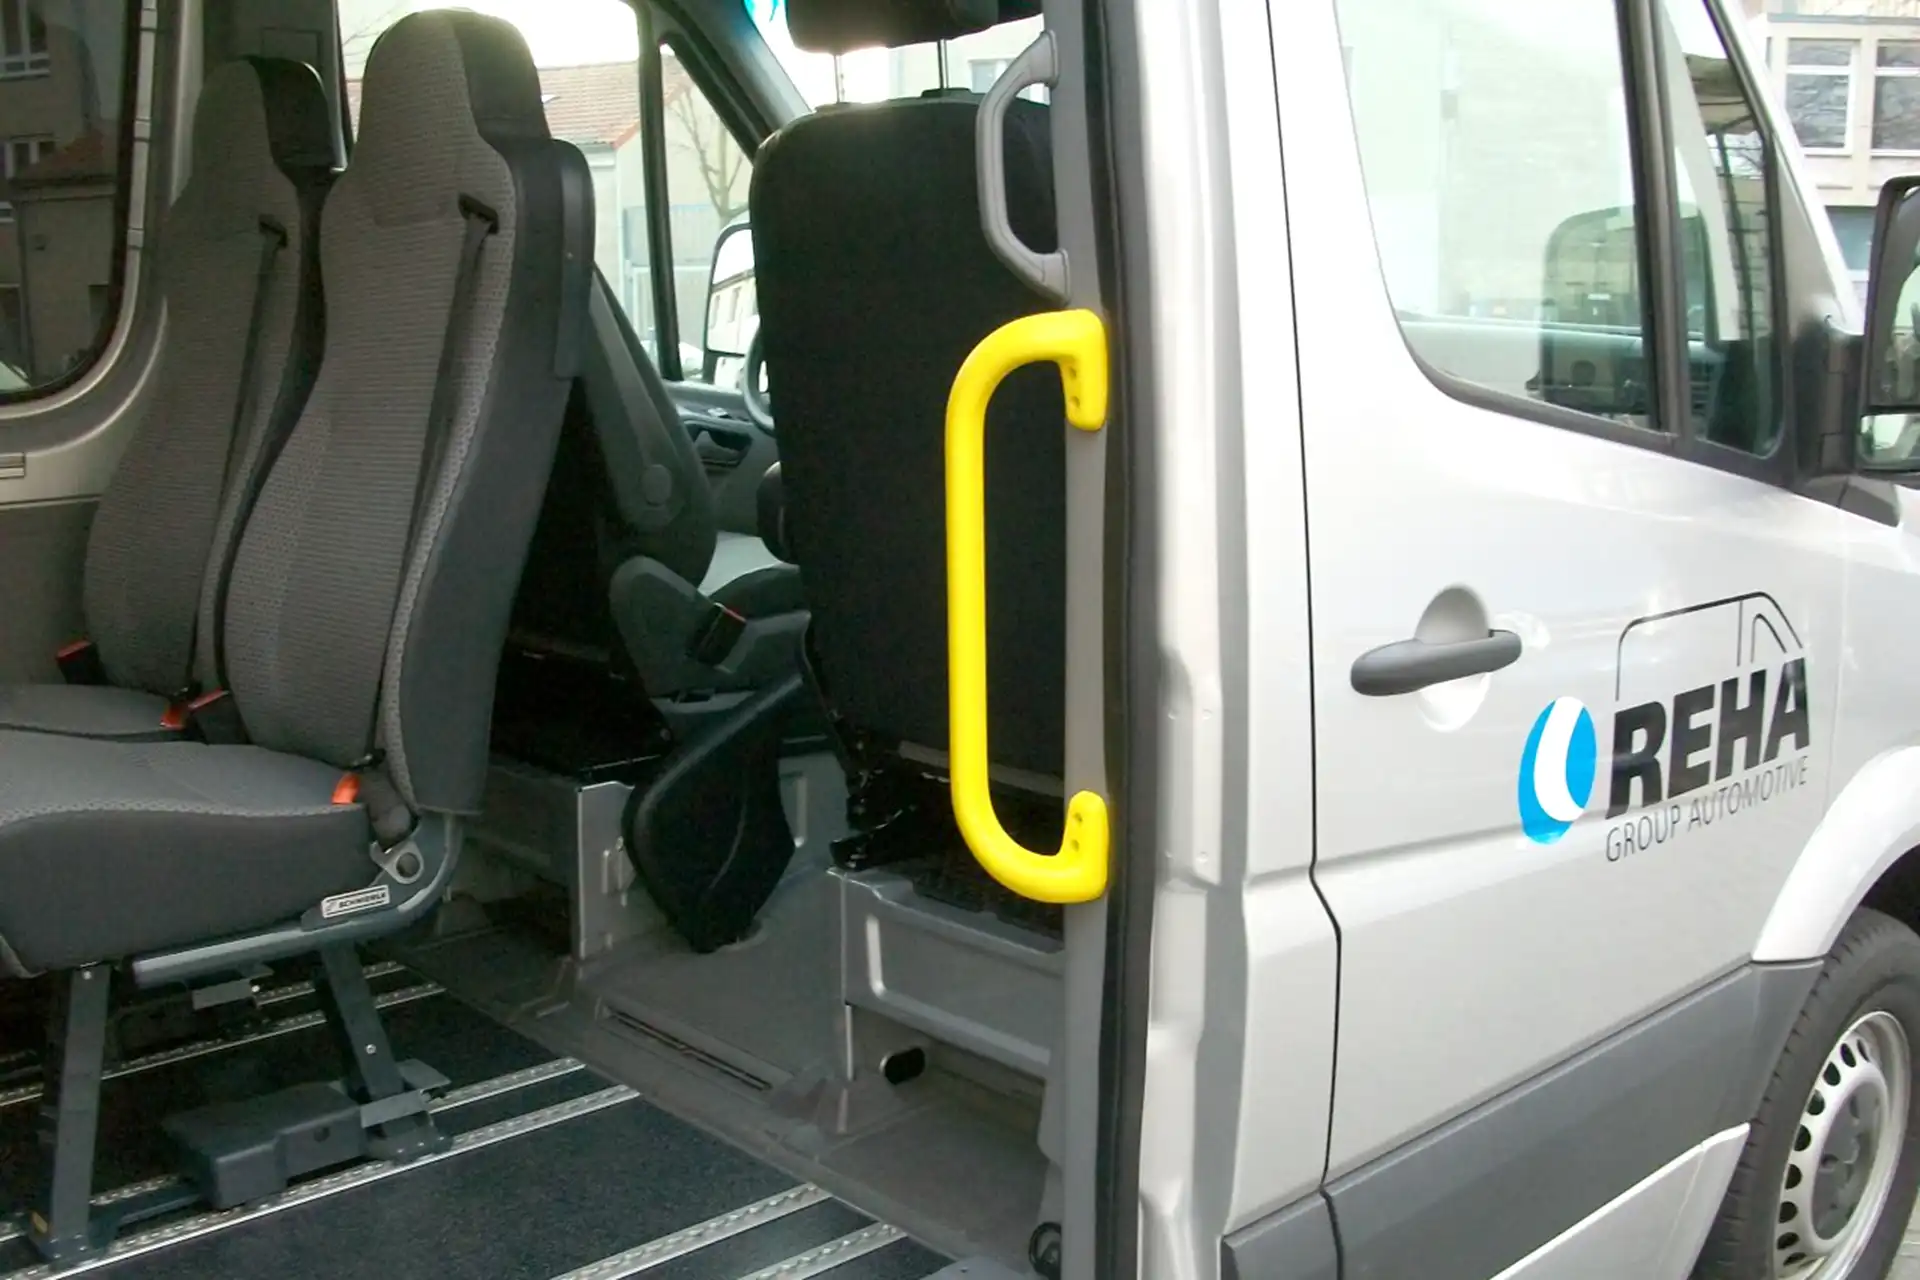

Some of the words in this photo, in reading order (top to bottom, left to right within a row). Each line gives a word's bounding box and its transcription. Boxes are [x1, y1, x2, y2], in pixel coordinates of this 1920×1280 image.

[1605, 657, 1809, 819] REHA
[1606, 805, 1681, 862] GROUP
[1687, 755, 1808, 832] AUTOMOTIVE
